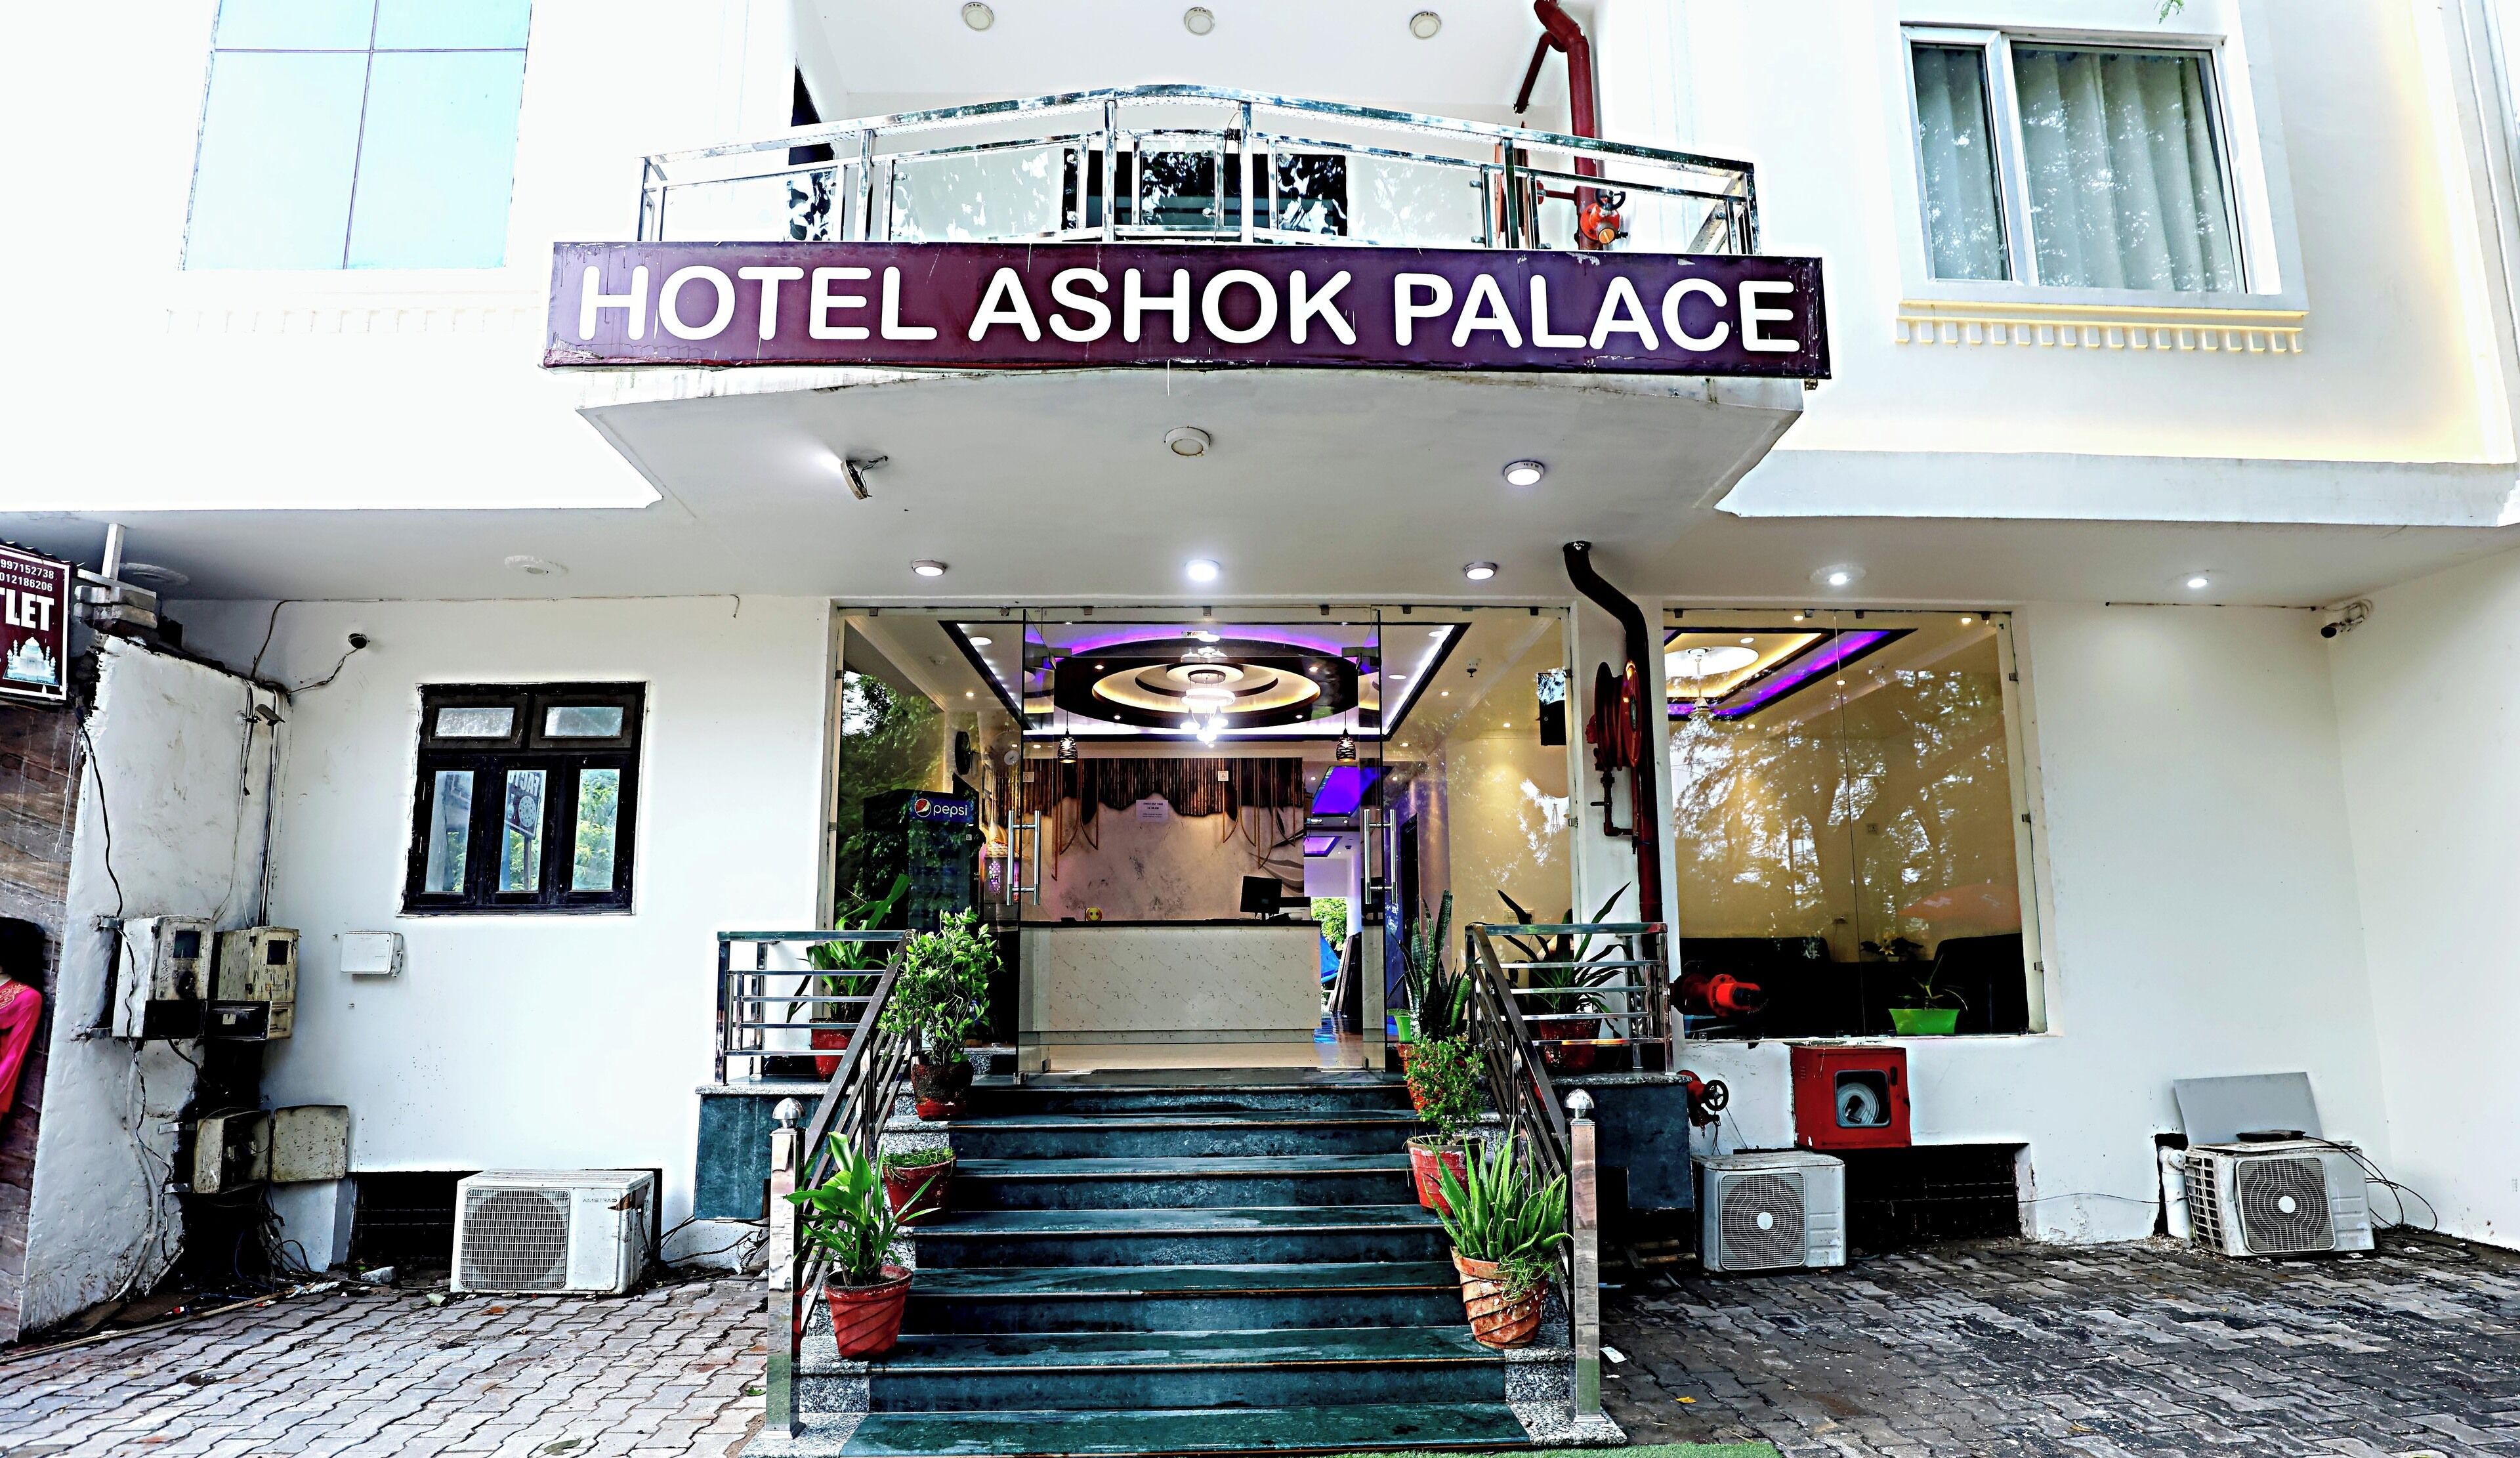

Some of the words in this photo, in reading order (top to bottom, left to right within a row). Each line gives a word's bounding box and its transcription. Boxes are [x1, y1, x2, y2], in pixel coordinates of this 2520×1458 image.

[578, 265, 938, 341] HOTEL
[968, 267, 1356, 345] ASHOK
[1394, 272, 1800, 352] PALACE
[0, 559, 54, 579] 997152738
[0, 572, 53, 591] 012186206
[933, 805, 967, 817] pepsi
